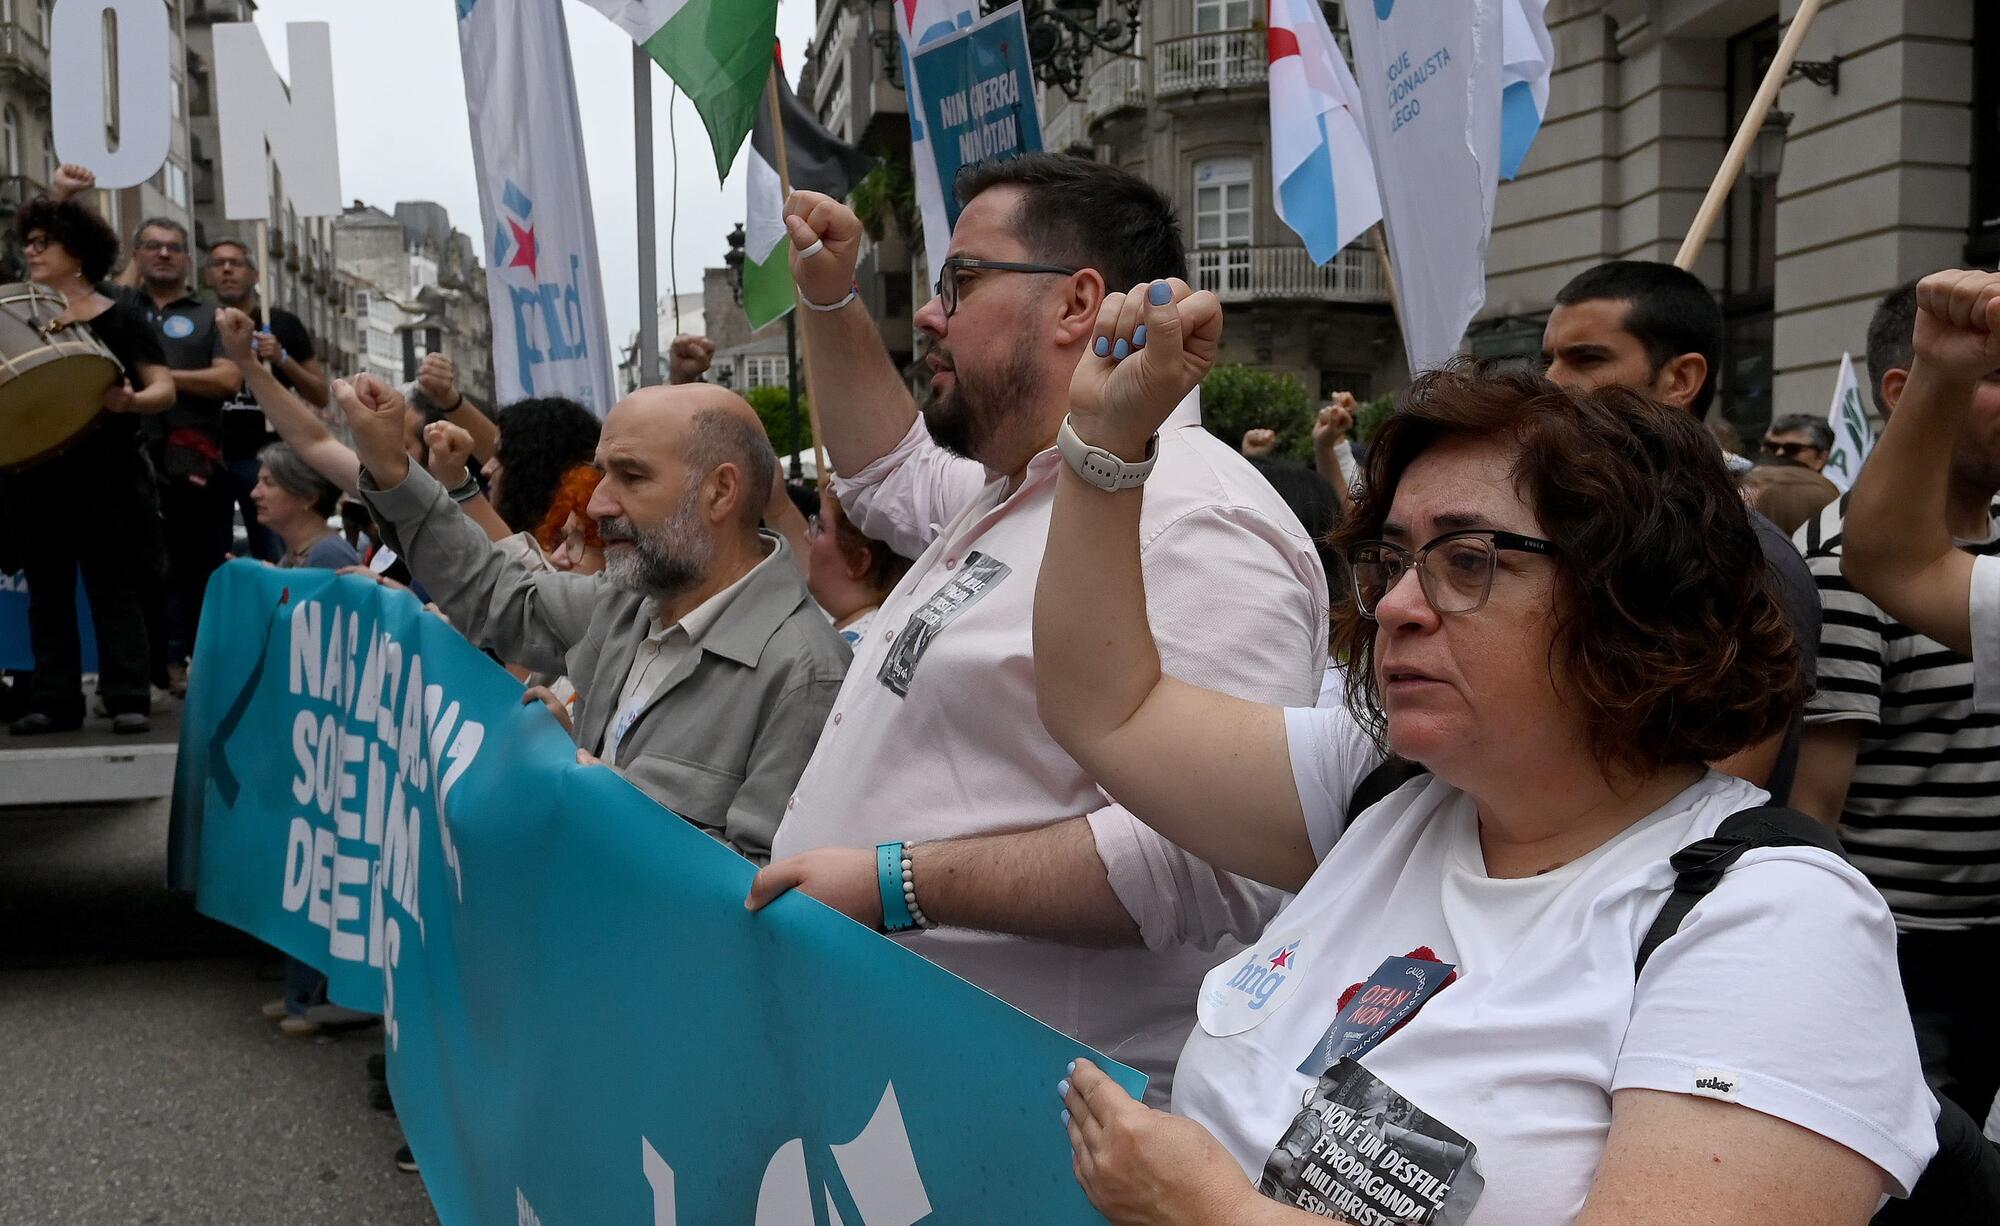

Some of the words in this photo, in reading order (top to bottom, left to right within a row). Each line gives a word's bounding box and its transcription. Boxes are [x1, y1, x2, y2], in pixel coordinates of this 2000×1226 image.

[940, 89, 968, 130] NIN
[969, 70, 1020, 120] GUERRA
[958, 128, 985, 165] NIN
[983, 114, 1017, 157] OTAN
[1226, 953, 1287, 1010] bng
[1360, 984, 1413, 1009] OTAN
[1346, 1004, 1393, 1025] NON
[1319, 1143, 1427, 1222] PROPAGANDA
[1320, 1103, 1355, 1137] NON
[1357, 1132, 1388, 1162] UN
[1379, 1149, 1451, 1211] DESFILE,
